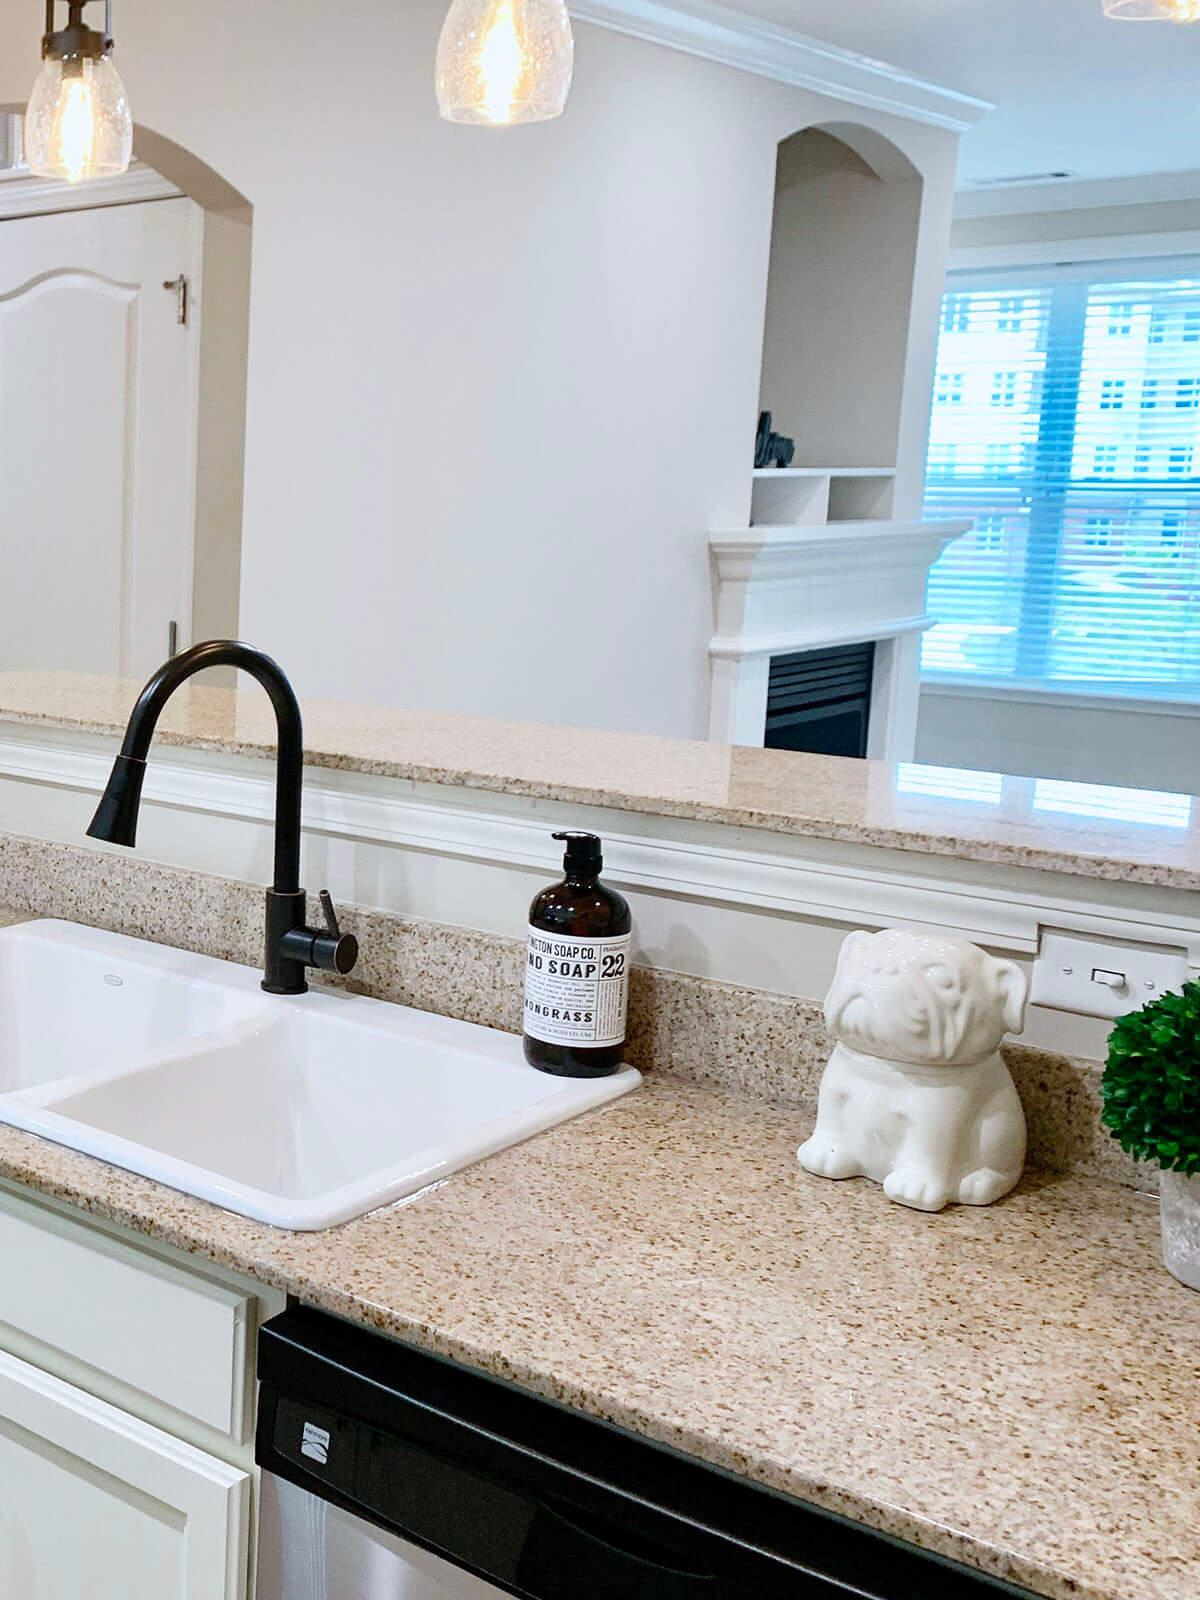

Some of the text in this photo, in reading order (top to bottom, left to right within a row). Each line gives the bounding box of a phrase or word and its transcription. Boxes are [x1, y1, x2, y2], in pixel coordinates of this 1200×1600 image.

[554, 944, 579, 959] SOAP
[581, 948, 597, 960] CO.
[548, 960, 596, 978] SOAP
[601, 953, 625, 978] 22
